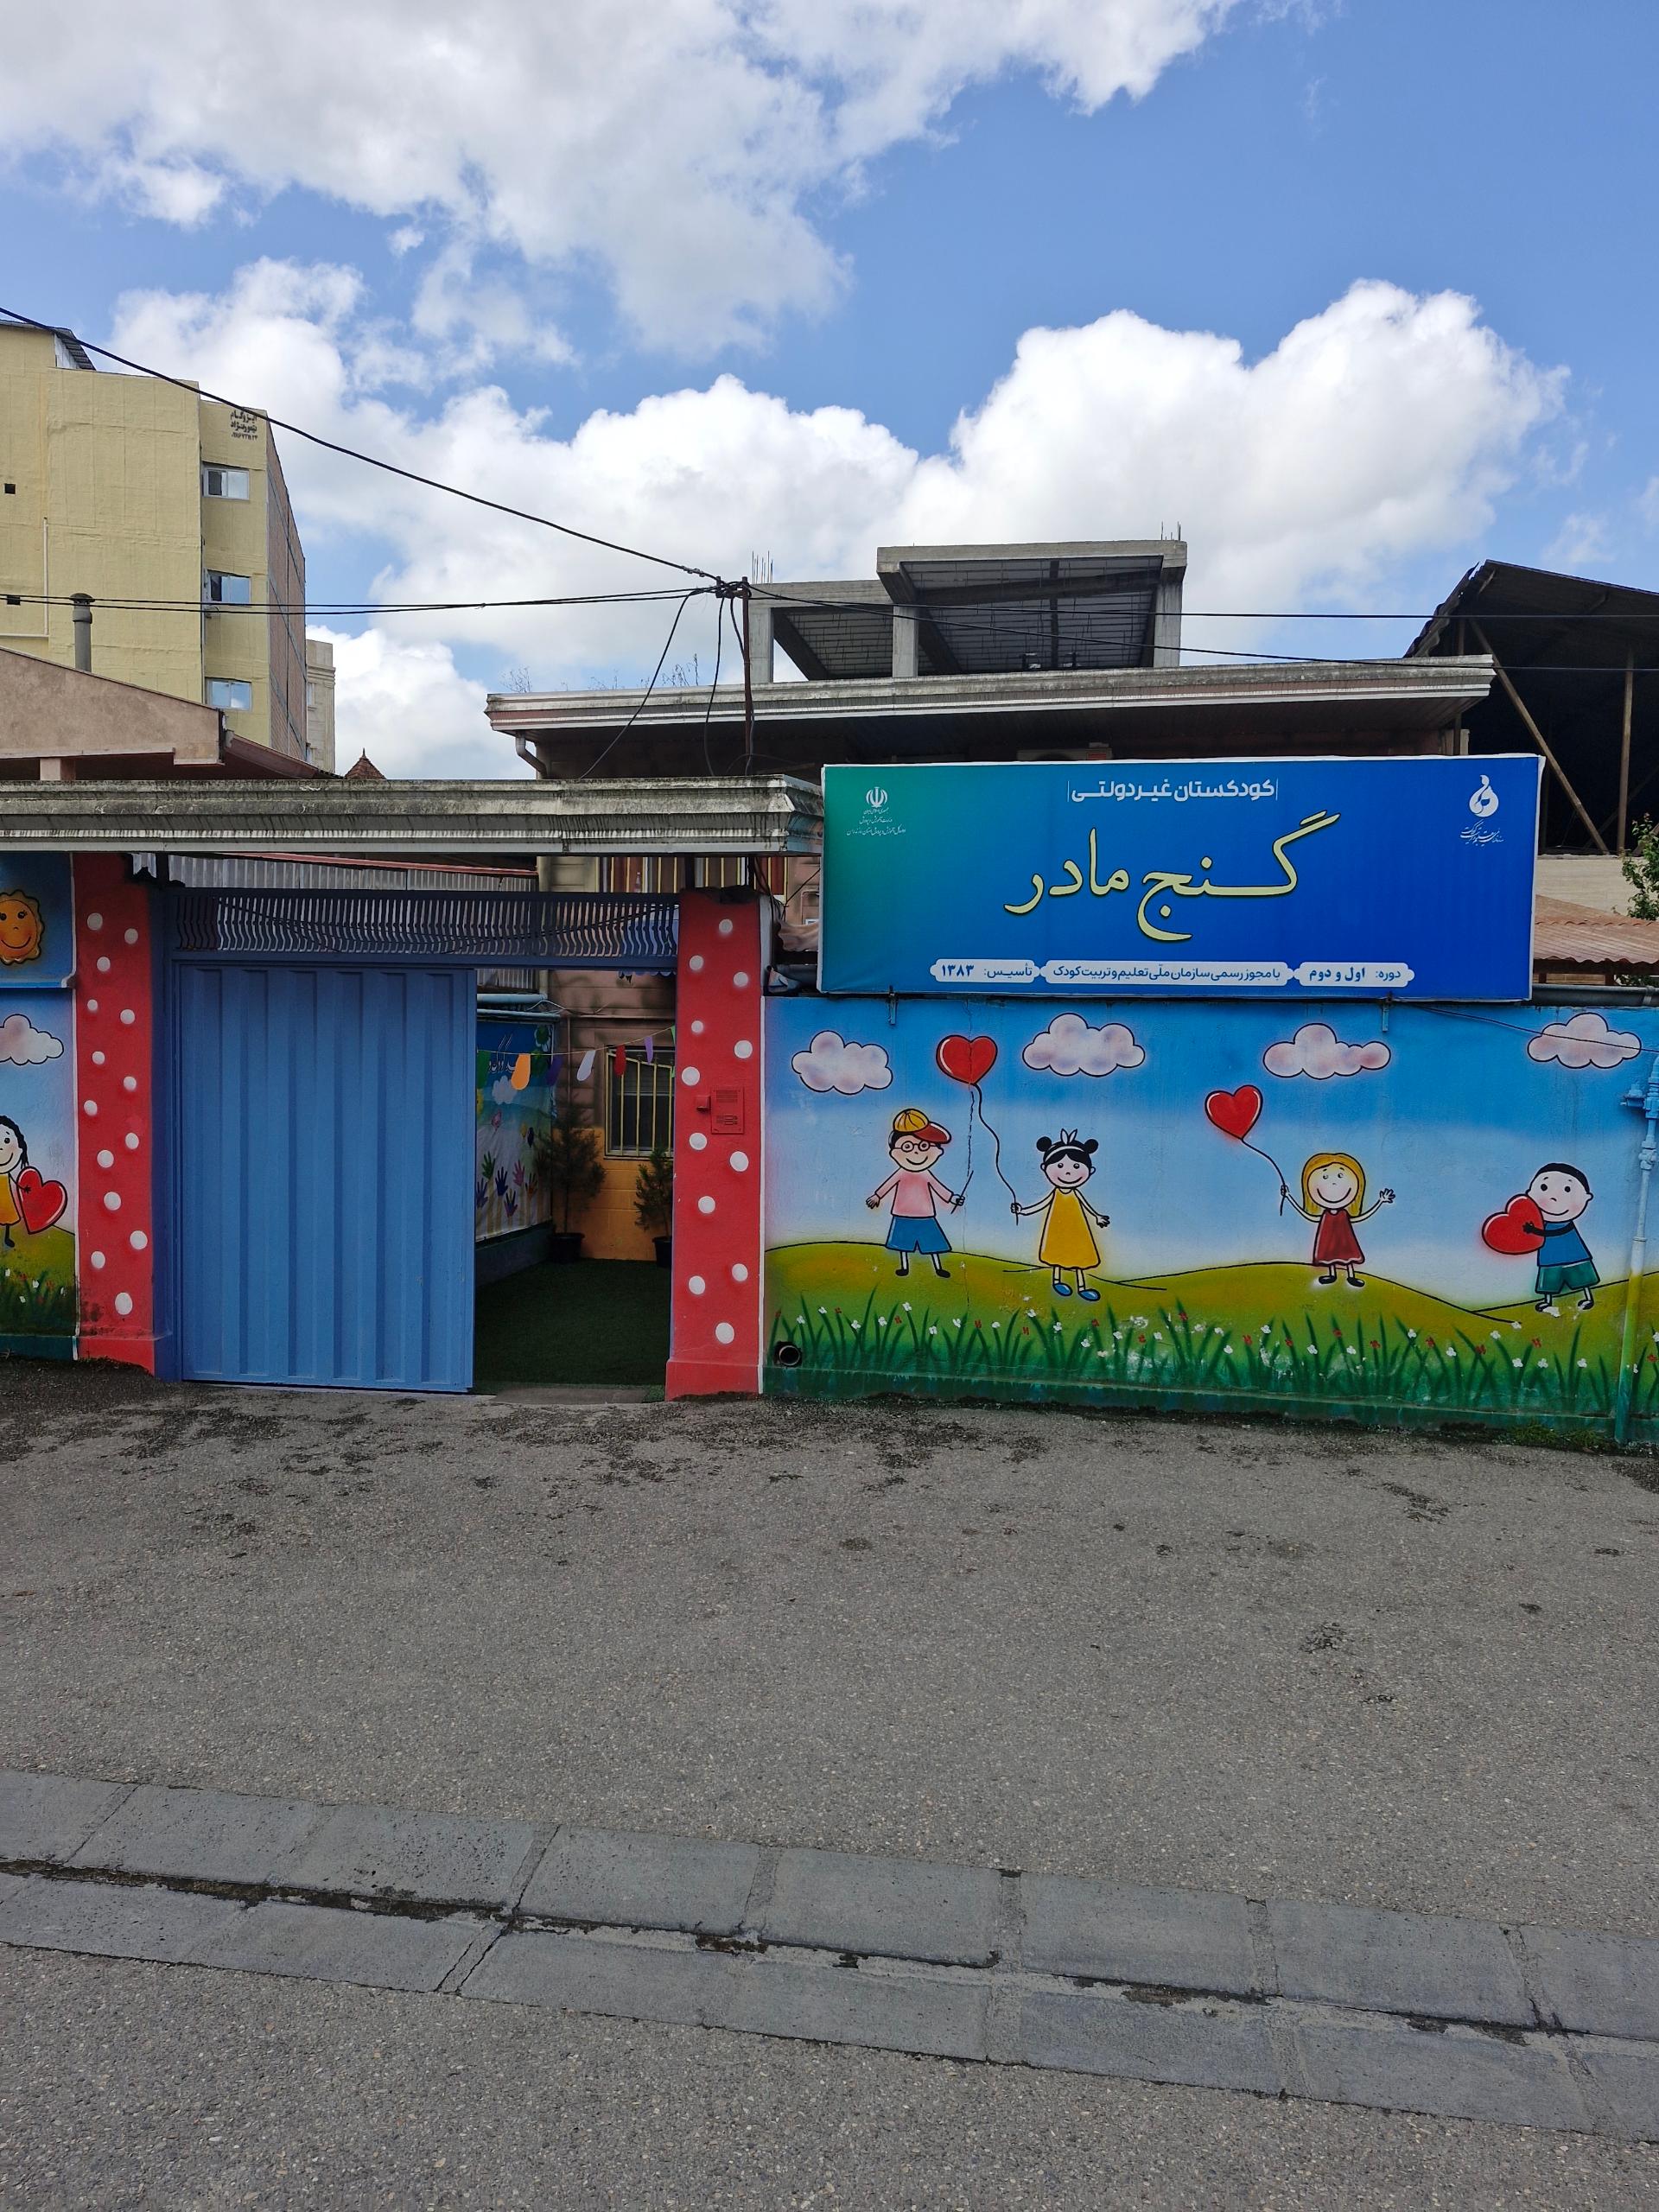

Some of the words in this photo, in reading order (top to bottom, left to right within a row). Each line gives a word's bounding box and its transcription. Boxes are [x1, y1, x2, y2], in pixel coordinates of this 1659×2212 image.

[1174, 779, 1275, 802] کودکستان
[1004, 828, 1130, 914] مادر
[1137, 810, 1341, 941] گنج
[942, 964, 975, 977] ۱۳۸۳
[983, 963, 1033, 978] تأسیس:
[1053, 965, 1082, 979] کودک
[1082, 967, 1111, 980] تربیت
[1111, 969, 1118, 980] و
[1117, 967, 1148, 981] تعلیم
[1171, 967, 1210, 981] سازمان
[1211, 969, 1243, 982] رسمی
[1244, 969, 1271, 982] مجوز
[1272, 968, 1281, 982] با
[1309, 968, 1332, 982] دوم
[1334, 969, 1341, 982] و
[1344, 966, 1365, 982] اول
[1375, 969, 1402, 982] دوره:
